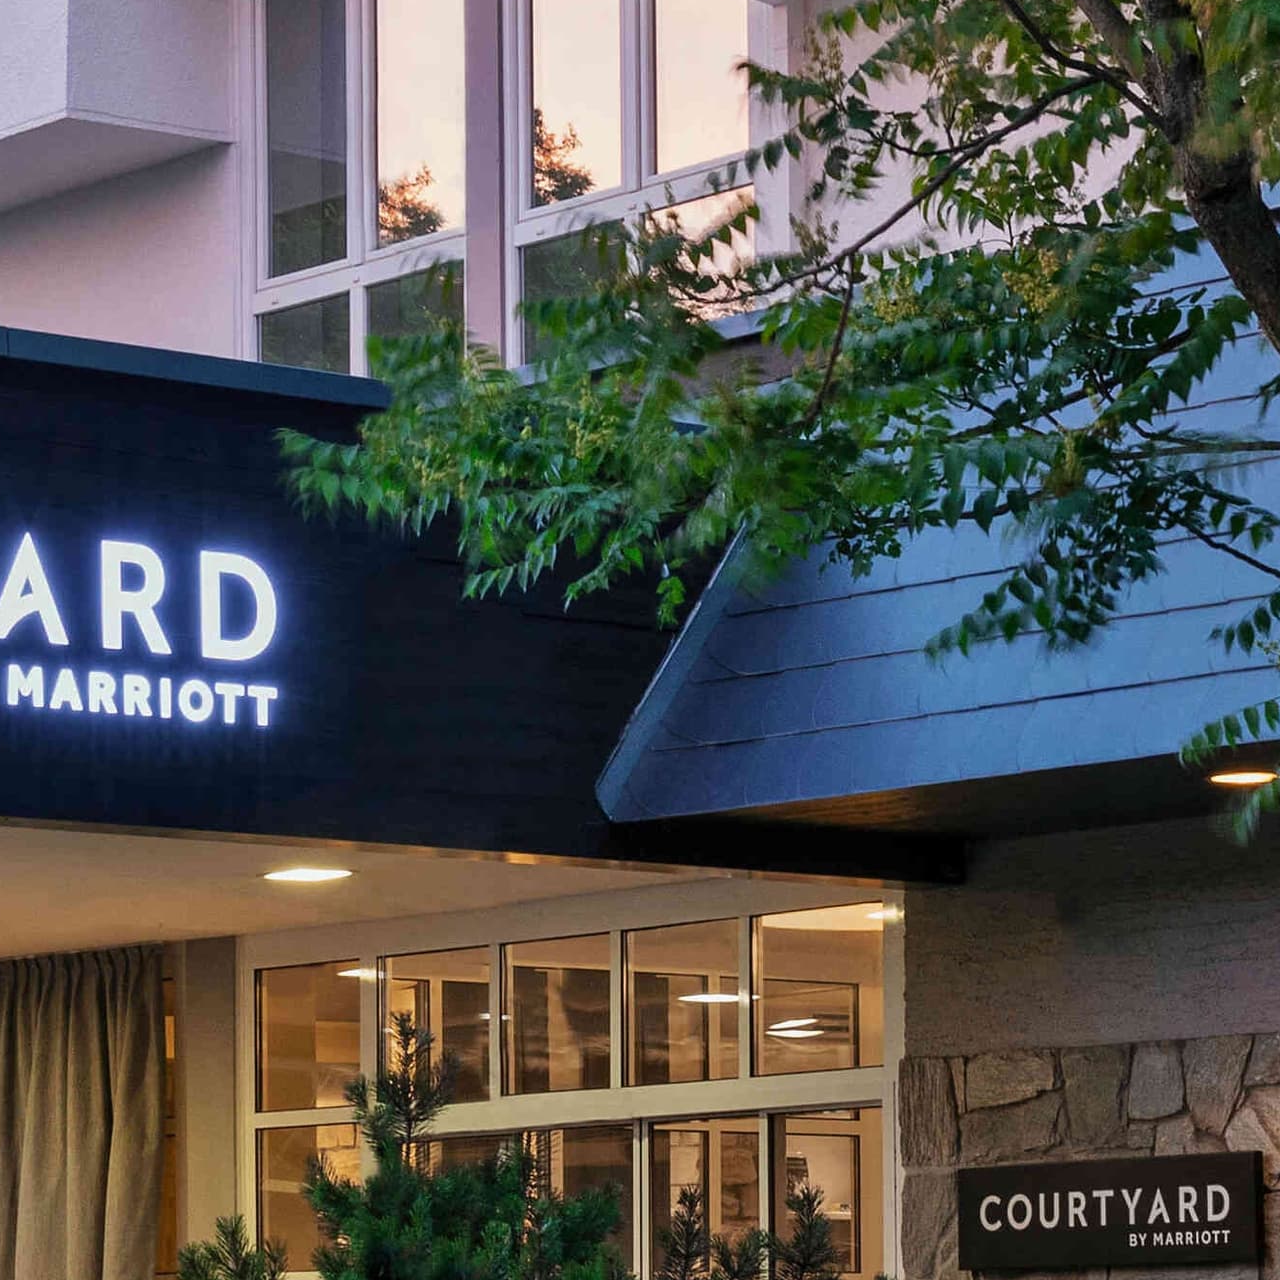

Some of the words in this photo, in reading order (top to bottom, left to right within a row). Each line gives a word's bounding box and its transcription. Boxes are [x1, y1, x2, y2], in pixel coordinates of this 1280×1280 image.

[6, 663, 279, 727] MARRIOTT
[979, 1184, 1231, 1232] COURTYARD
[1128, 1232, 1147, 1247] BY
[1152, 1229, 1231, 1247] MARRIOTT
